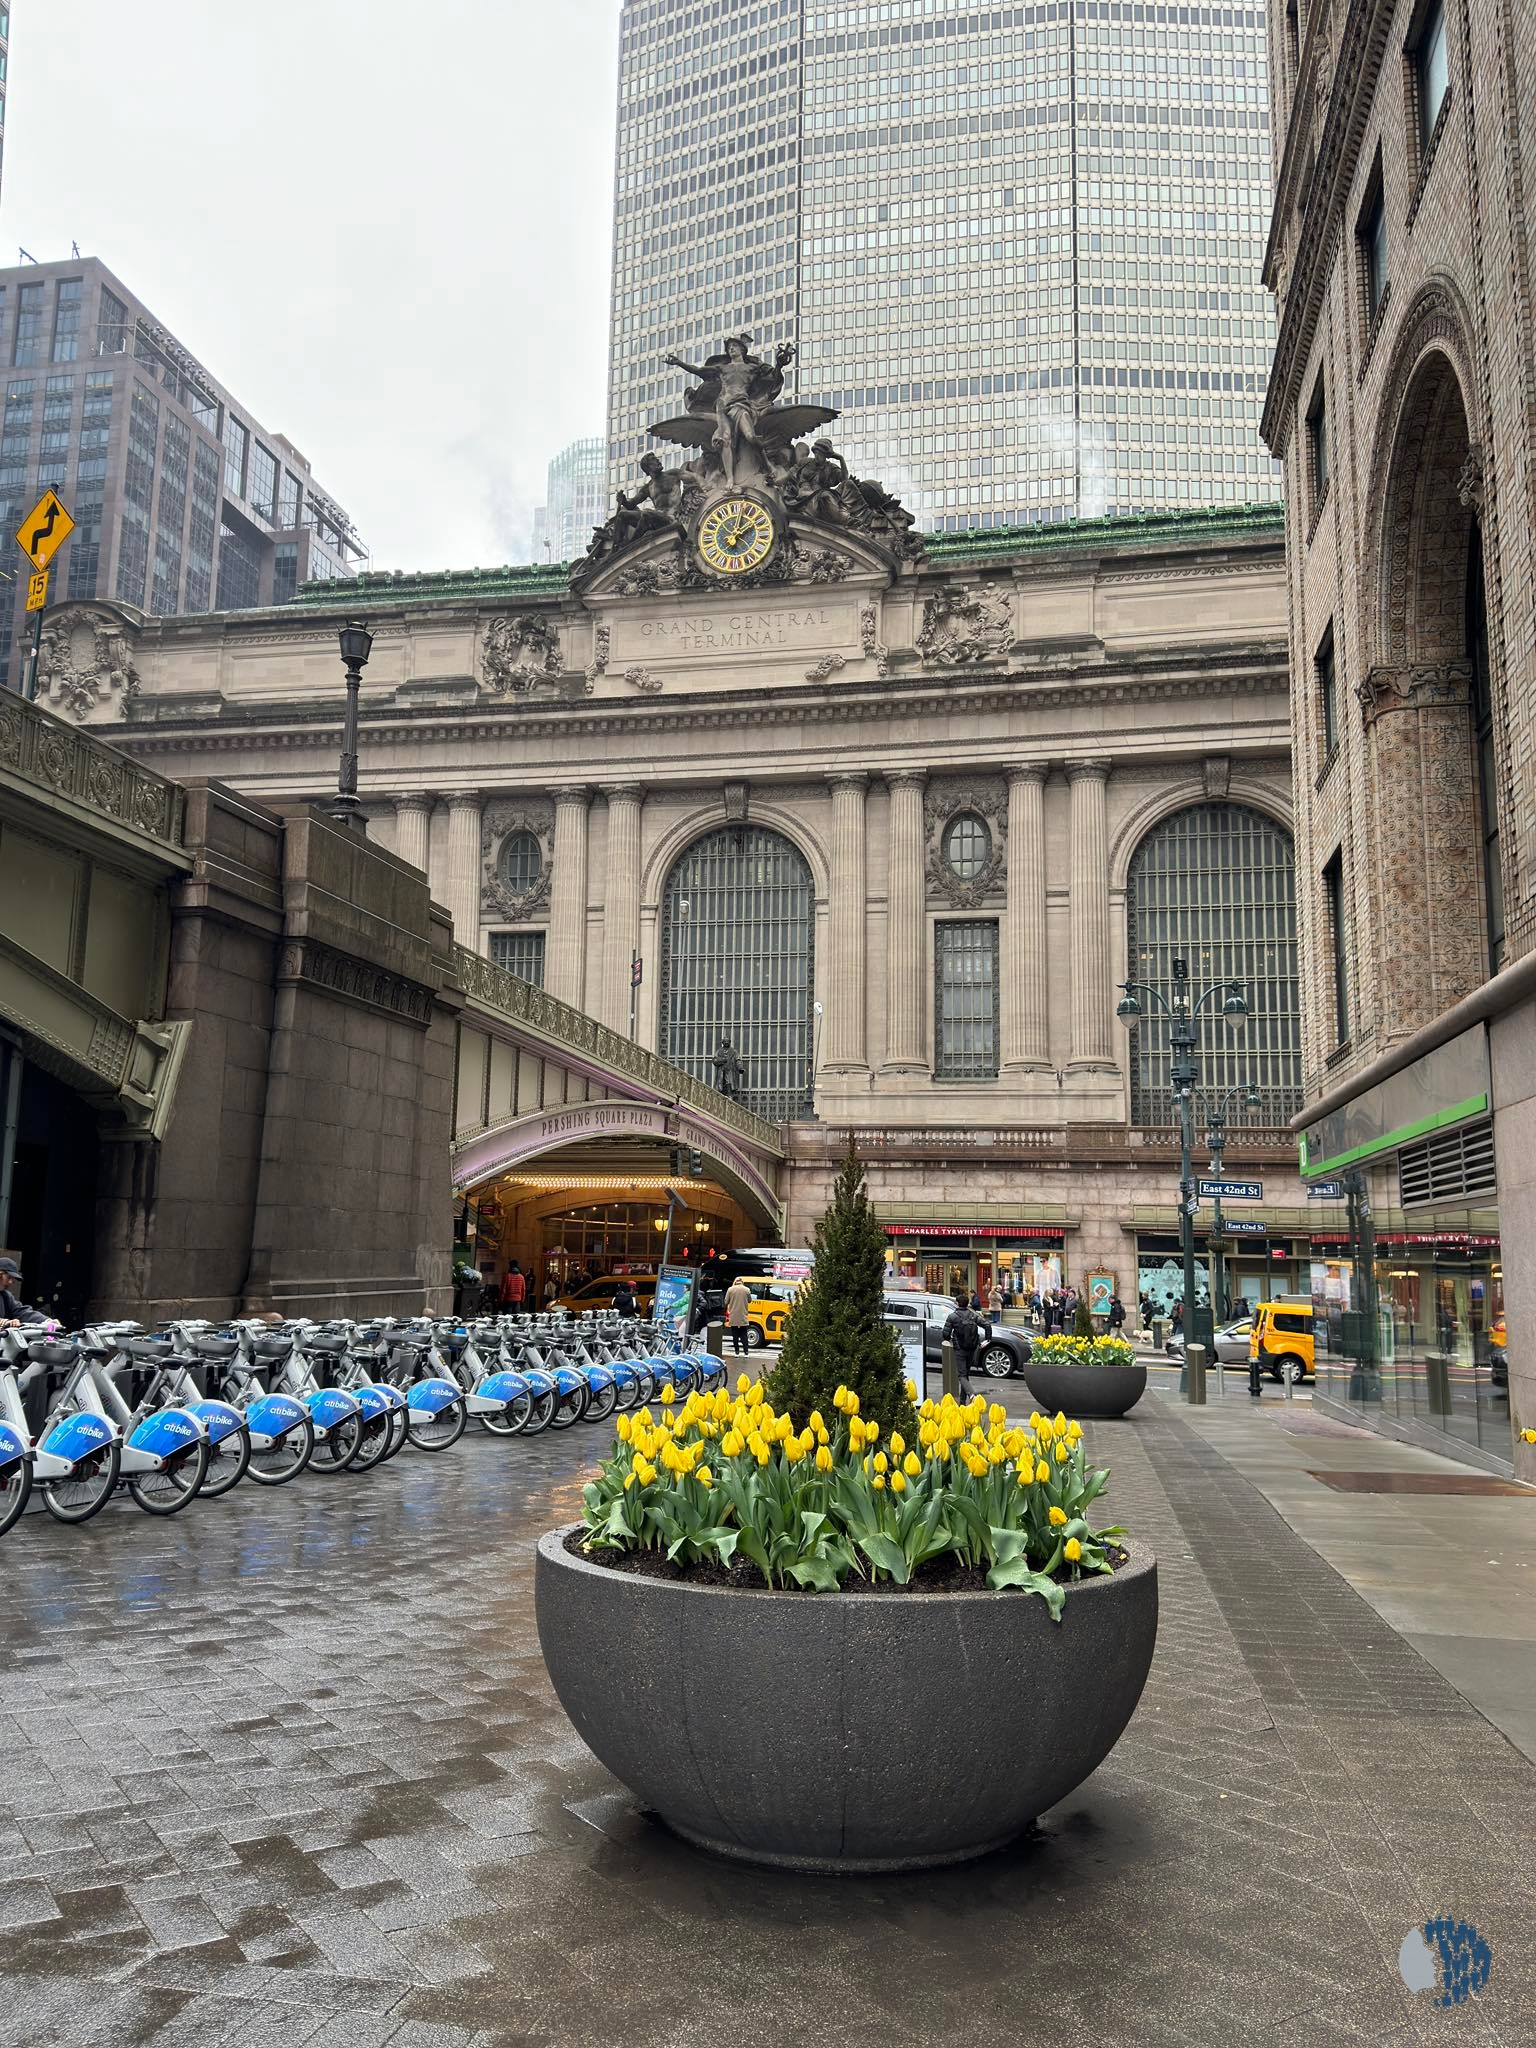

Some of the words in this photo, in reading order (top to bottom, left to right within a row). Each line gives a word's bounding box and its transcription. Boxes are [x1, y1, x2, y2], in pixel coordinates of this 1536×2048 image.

[32, 576, 44, 595] 15
[640, 619, 713, 636] GRAND
[729, 611, 829, 630] CENTRAL
[681, 630, 786, 649] TERMINAL
[542, 1112, 590, 1136] PERSHING
[595, 1111, 626, 1127] SQUARE
[630, 1112, 653, 1126] PLAZA
[1203, 1183, 1222, 1192] East
[1224, 1185, 1246, 1195] 42nd
[1248, 1186, 1258, 1195] St
[660, 1290, 677, 1299] Ride
